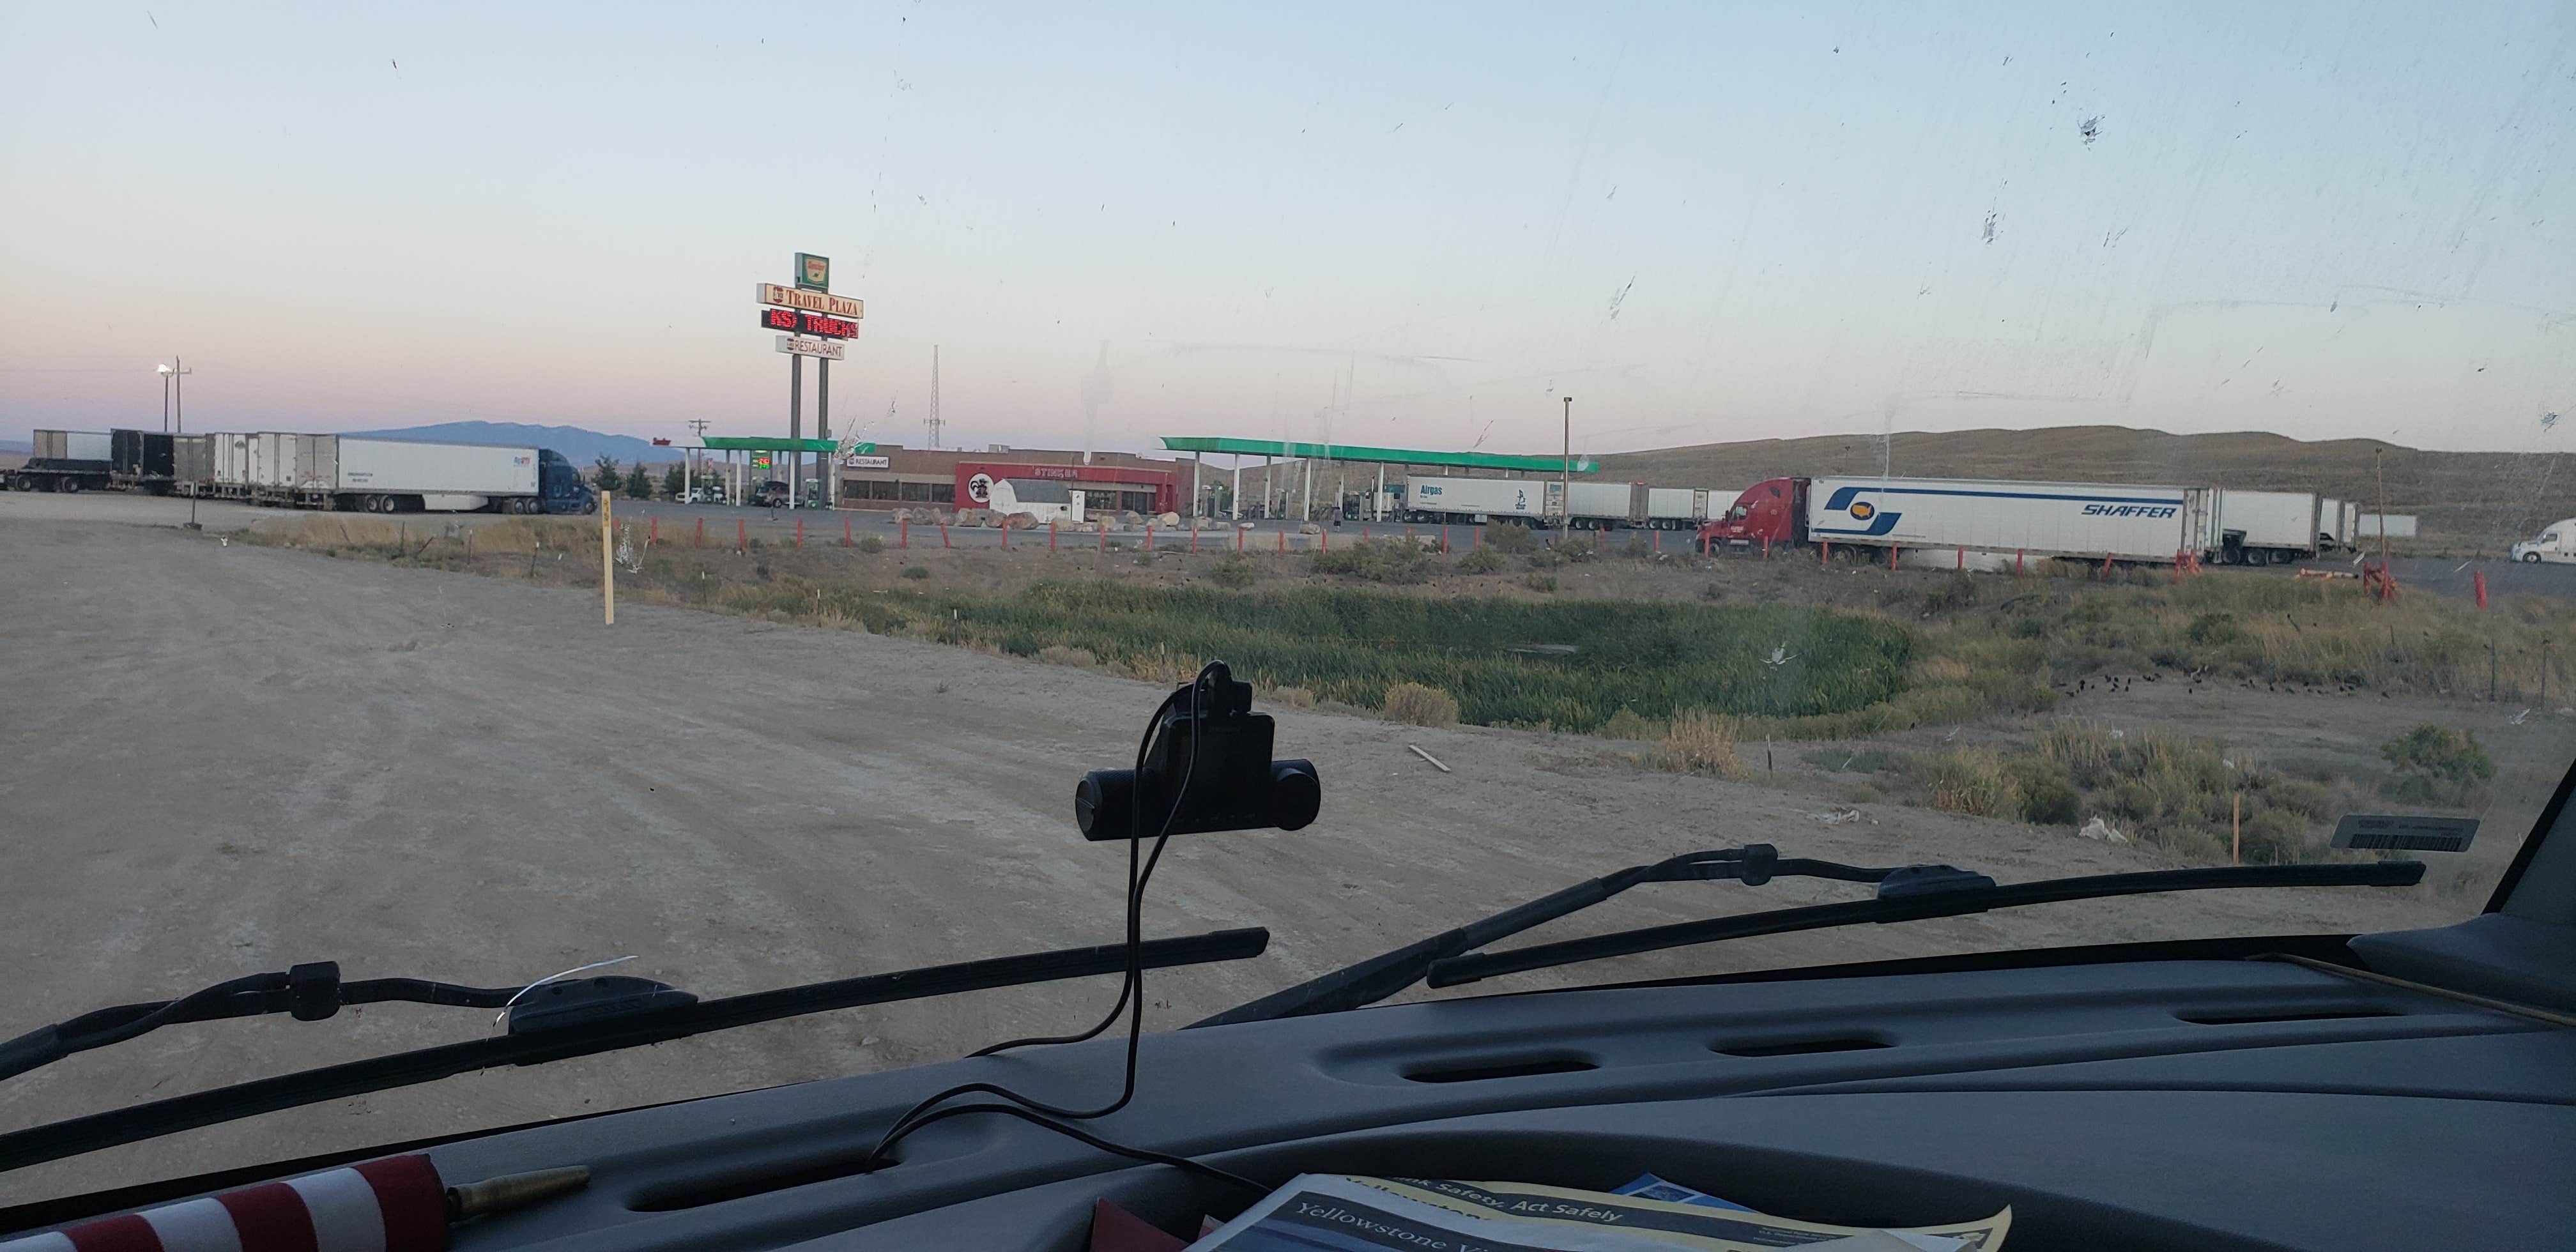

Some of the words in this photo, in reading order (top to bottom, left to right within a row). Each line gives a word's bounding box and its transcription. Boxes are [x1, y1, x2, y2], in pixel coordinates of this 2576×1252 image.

[786, 289, 824, 310] TRAVEL
[829, 297, 857, 316] PLAZA
[804, 315, 858, 338] TRUCKS
[794, 340, 842, 356] RESTAURANT
[1420, 485, 1443, 495] Airgas
[2082, 504, 2177, 518] SHAFFER
[1510, 1200, 1549, 1212] Act
[1552, 1204, 1625, 1223] Safely
[1296, 1202, 1447, 1249] Yellowstone
